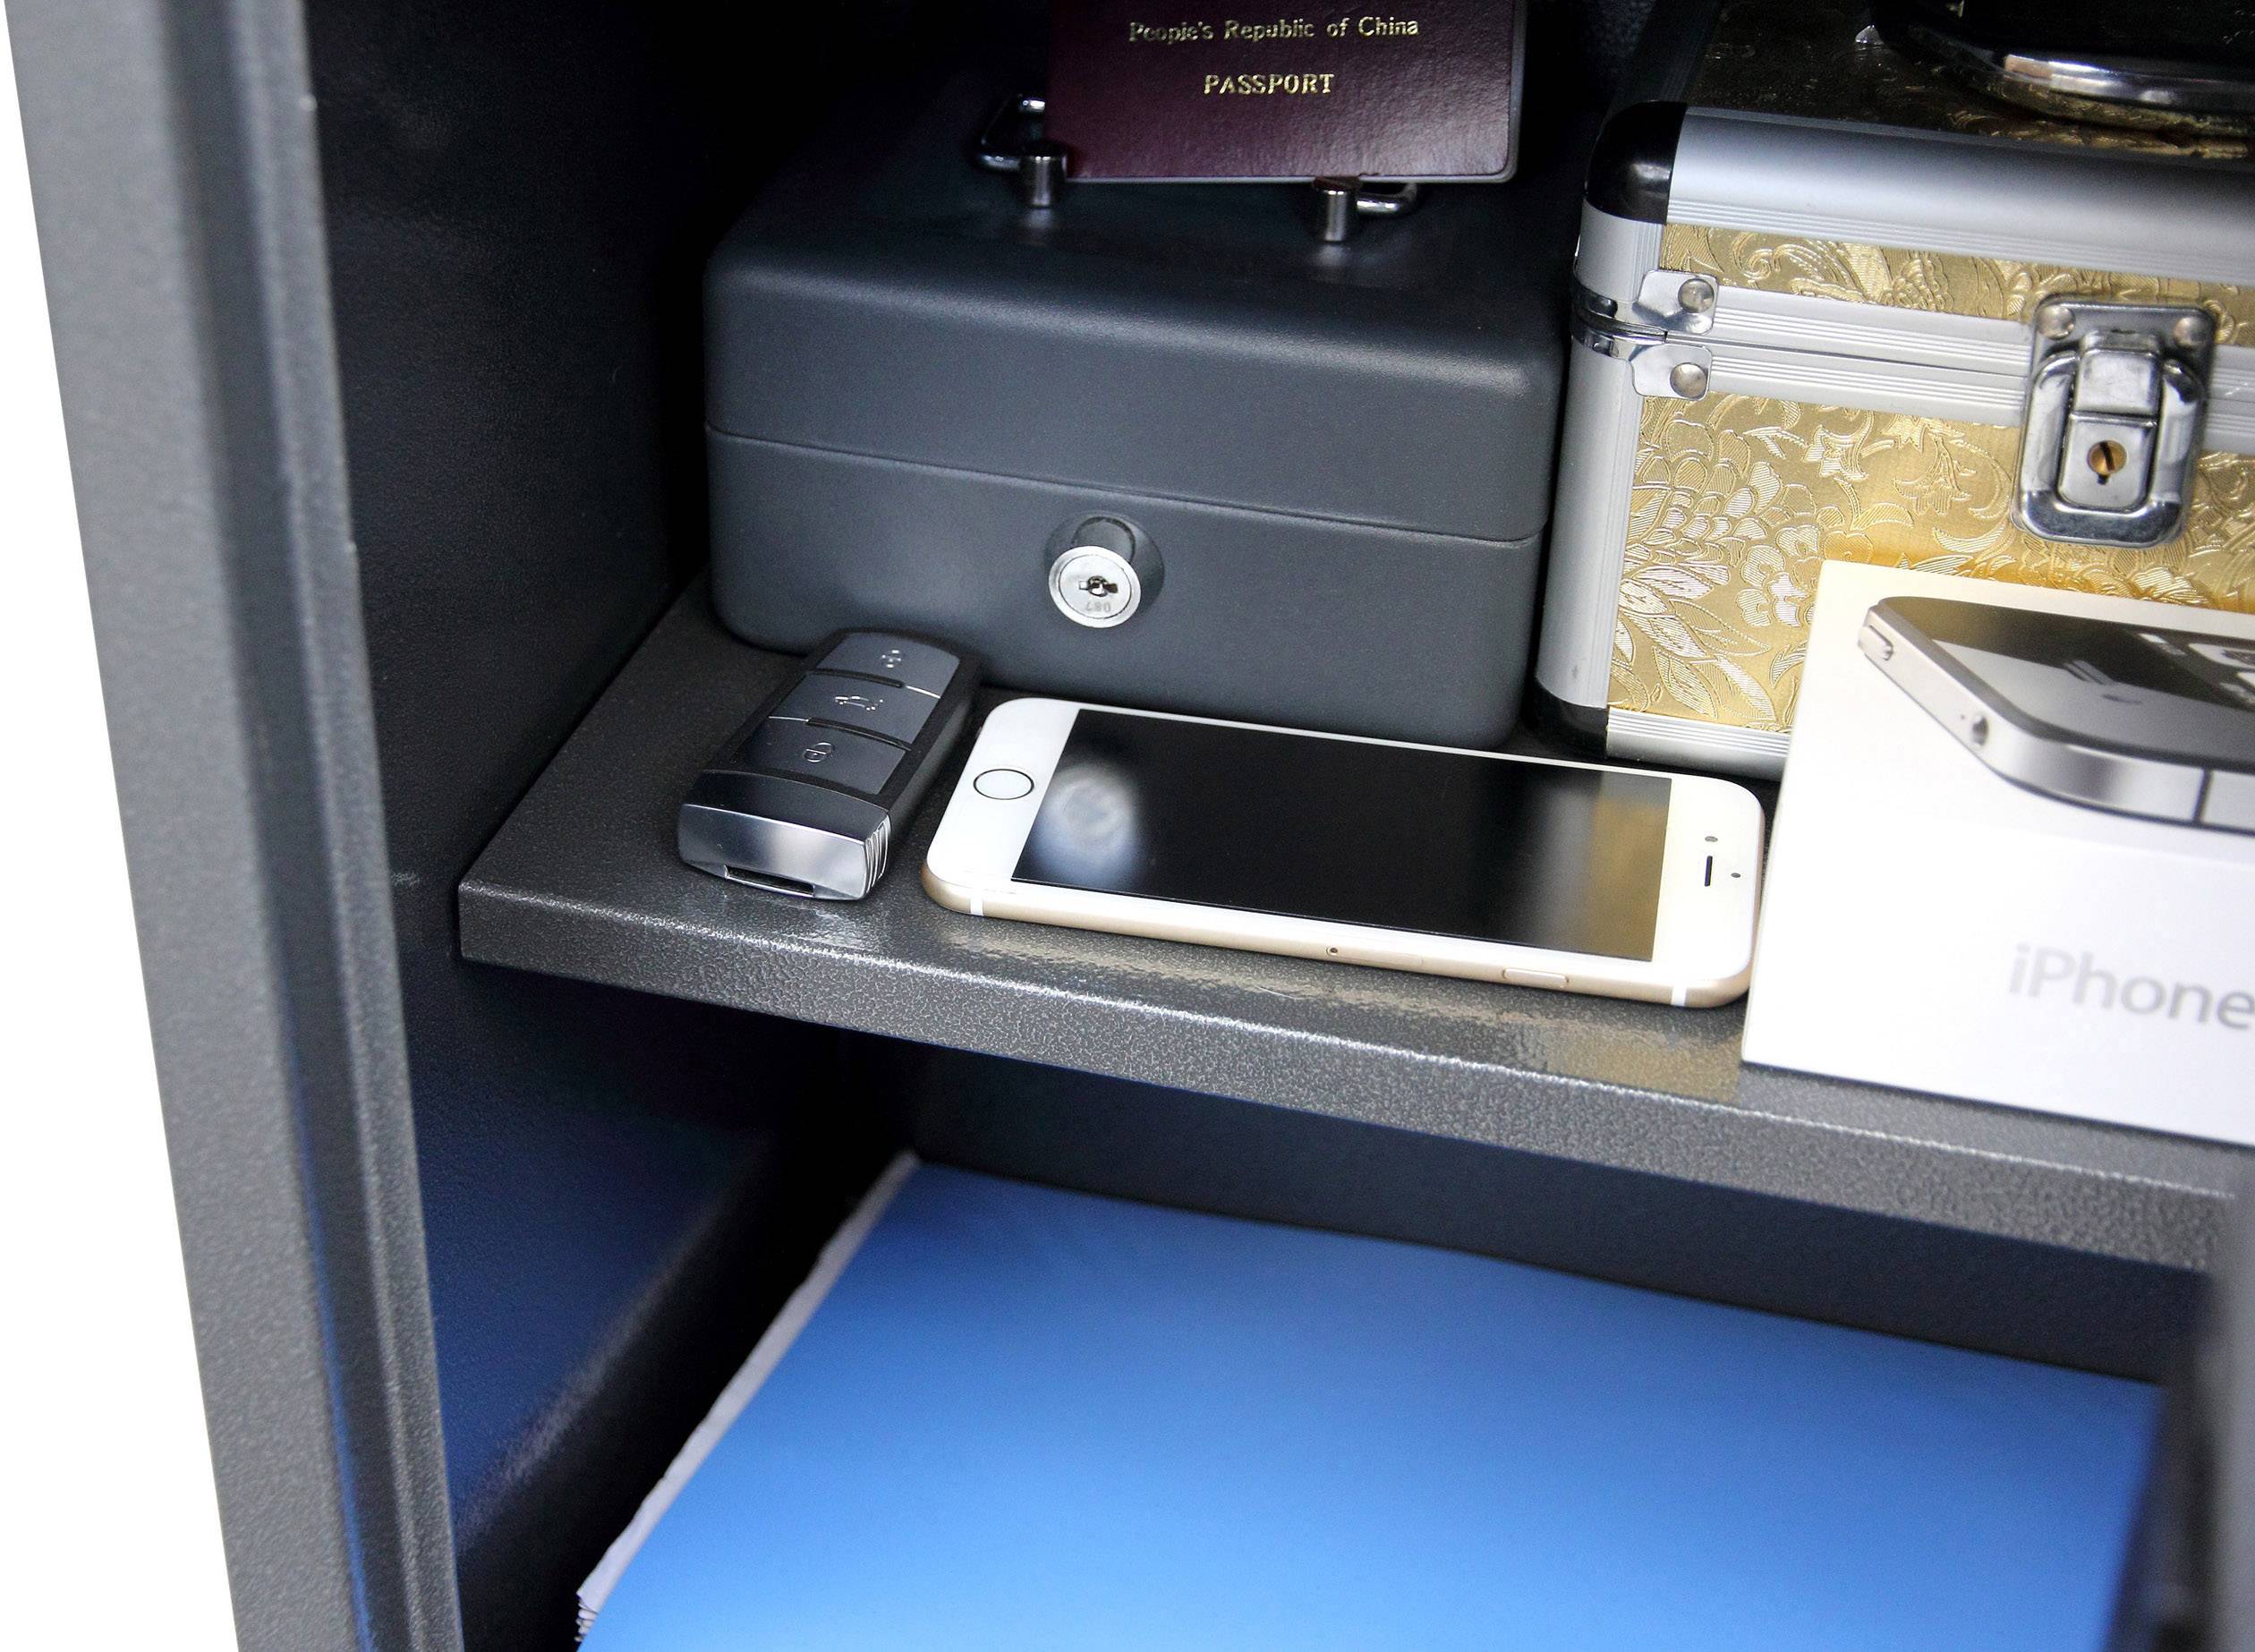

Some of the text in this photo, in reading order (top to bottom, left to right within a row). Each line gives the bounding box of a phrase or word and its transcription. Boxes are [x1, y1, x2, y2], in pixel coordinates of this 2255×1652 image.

[1128, 16, 1419, 45] People's Republic of China
[1203, 73, 1335, 95] PASSPORT
[2010, 943, 2255, 1030] iPhone
